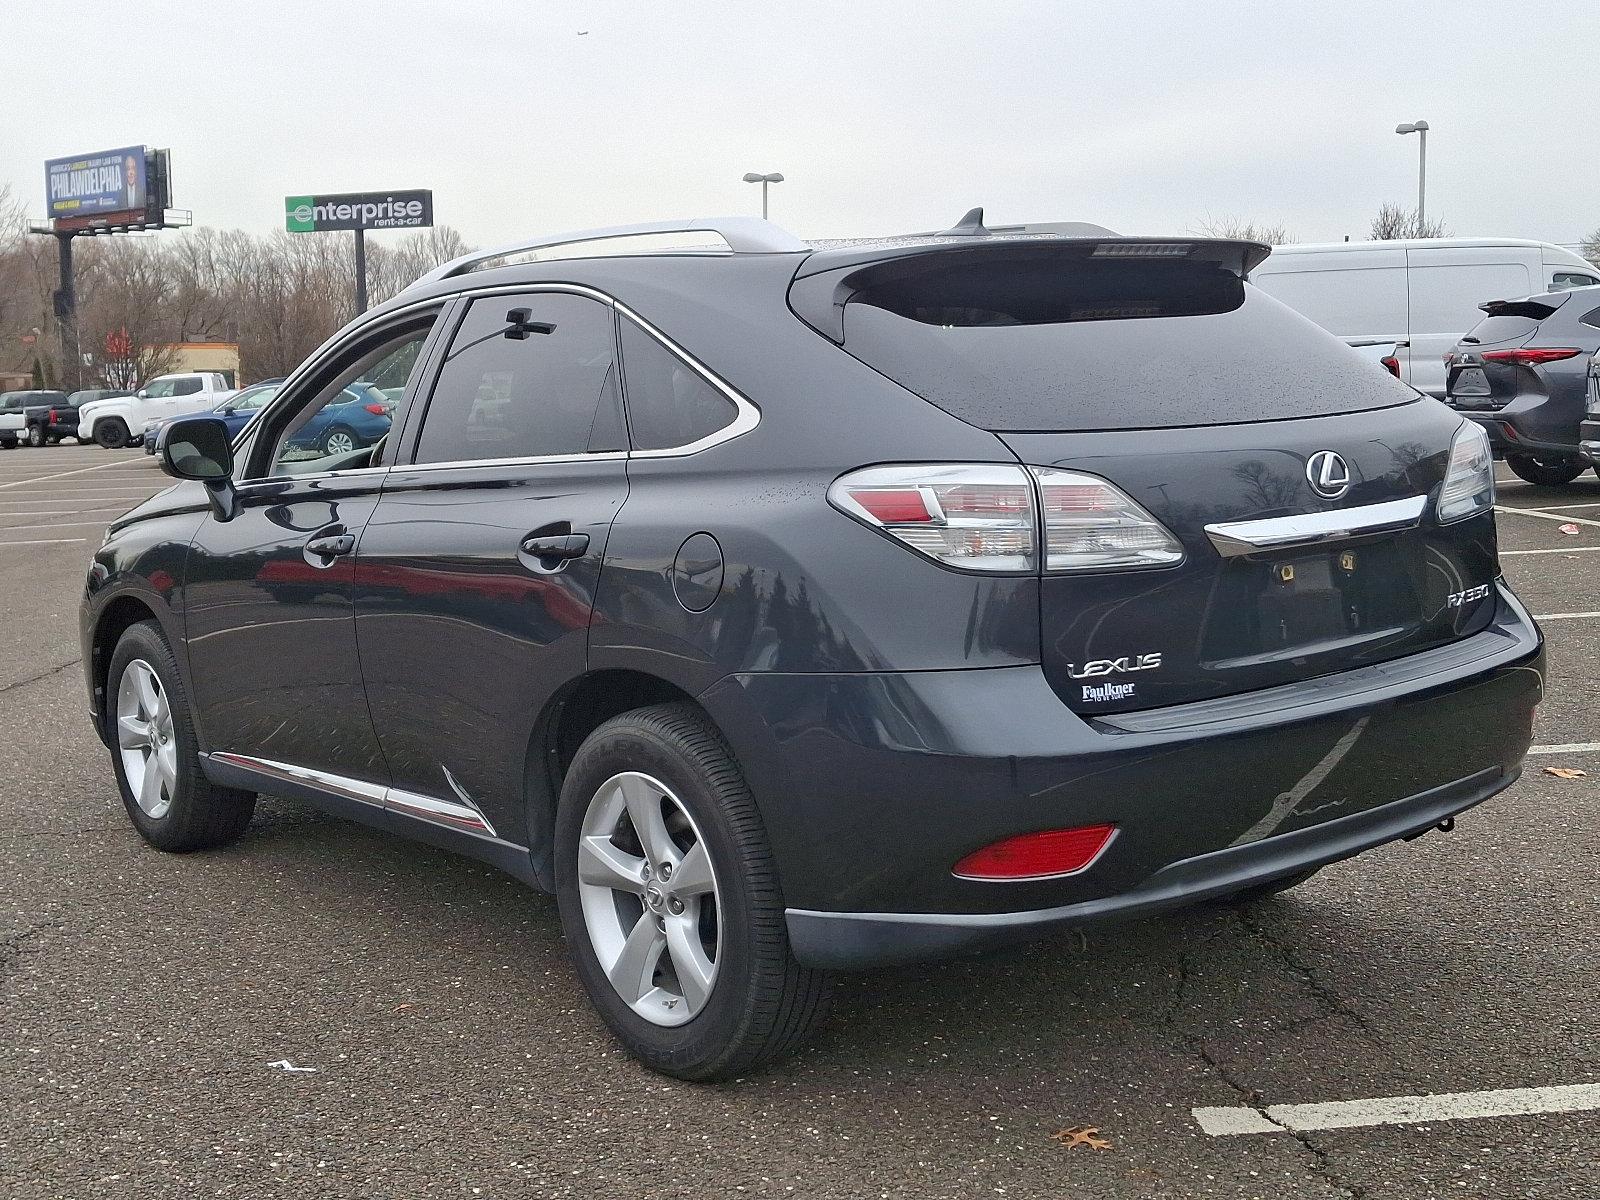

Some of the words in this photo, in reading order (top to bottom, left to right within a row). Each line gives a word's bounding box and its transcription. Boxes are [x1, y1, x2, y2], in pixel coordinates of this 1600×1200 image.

[51, 165, 122, 199] PHILAWDELPHIA
[294, 197, 423, 224] enterprise
[374, 217, 423, 227] rent-a-car
[1066, 652, 1162, 679] LEXUS
[1081, 682, 1135, 699] Faulkner
